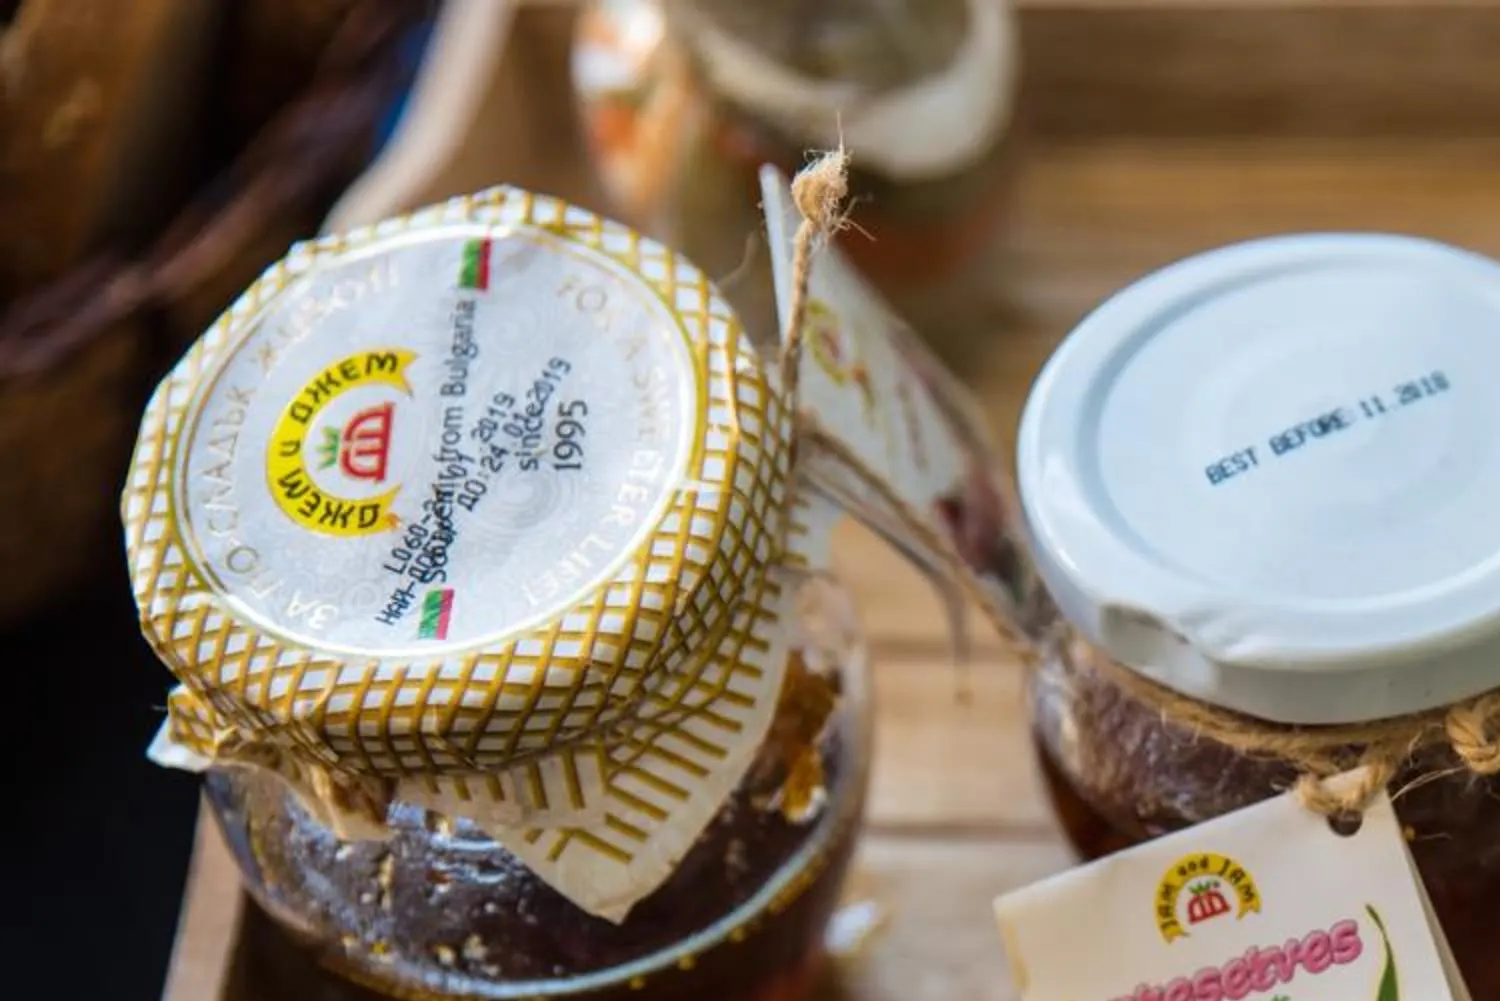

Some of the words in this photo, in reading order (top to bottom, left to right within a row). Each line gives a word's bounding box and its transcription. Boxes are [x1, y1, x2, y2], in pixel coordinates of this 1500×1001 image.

[439, 298, 480, 397] Bulgaria
[551, 399, 590, 472] 1995
[1205, 445, 1259, 485] BEST
[1268, 406, 1352, 457] BEFORE
